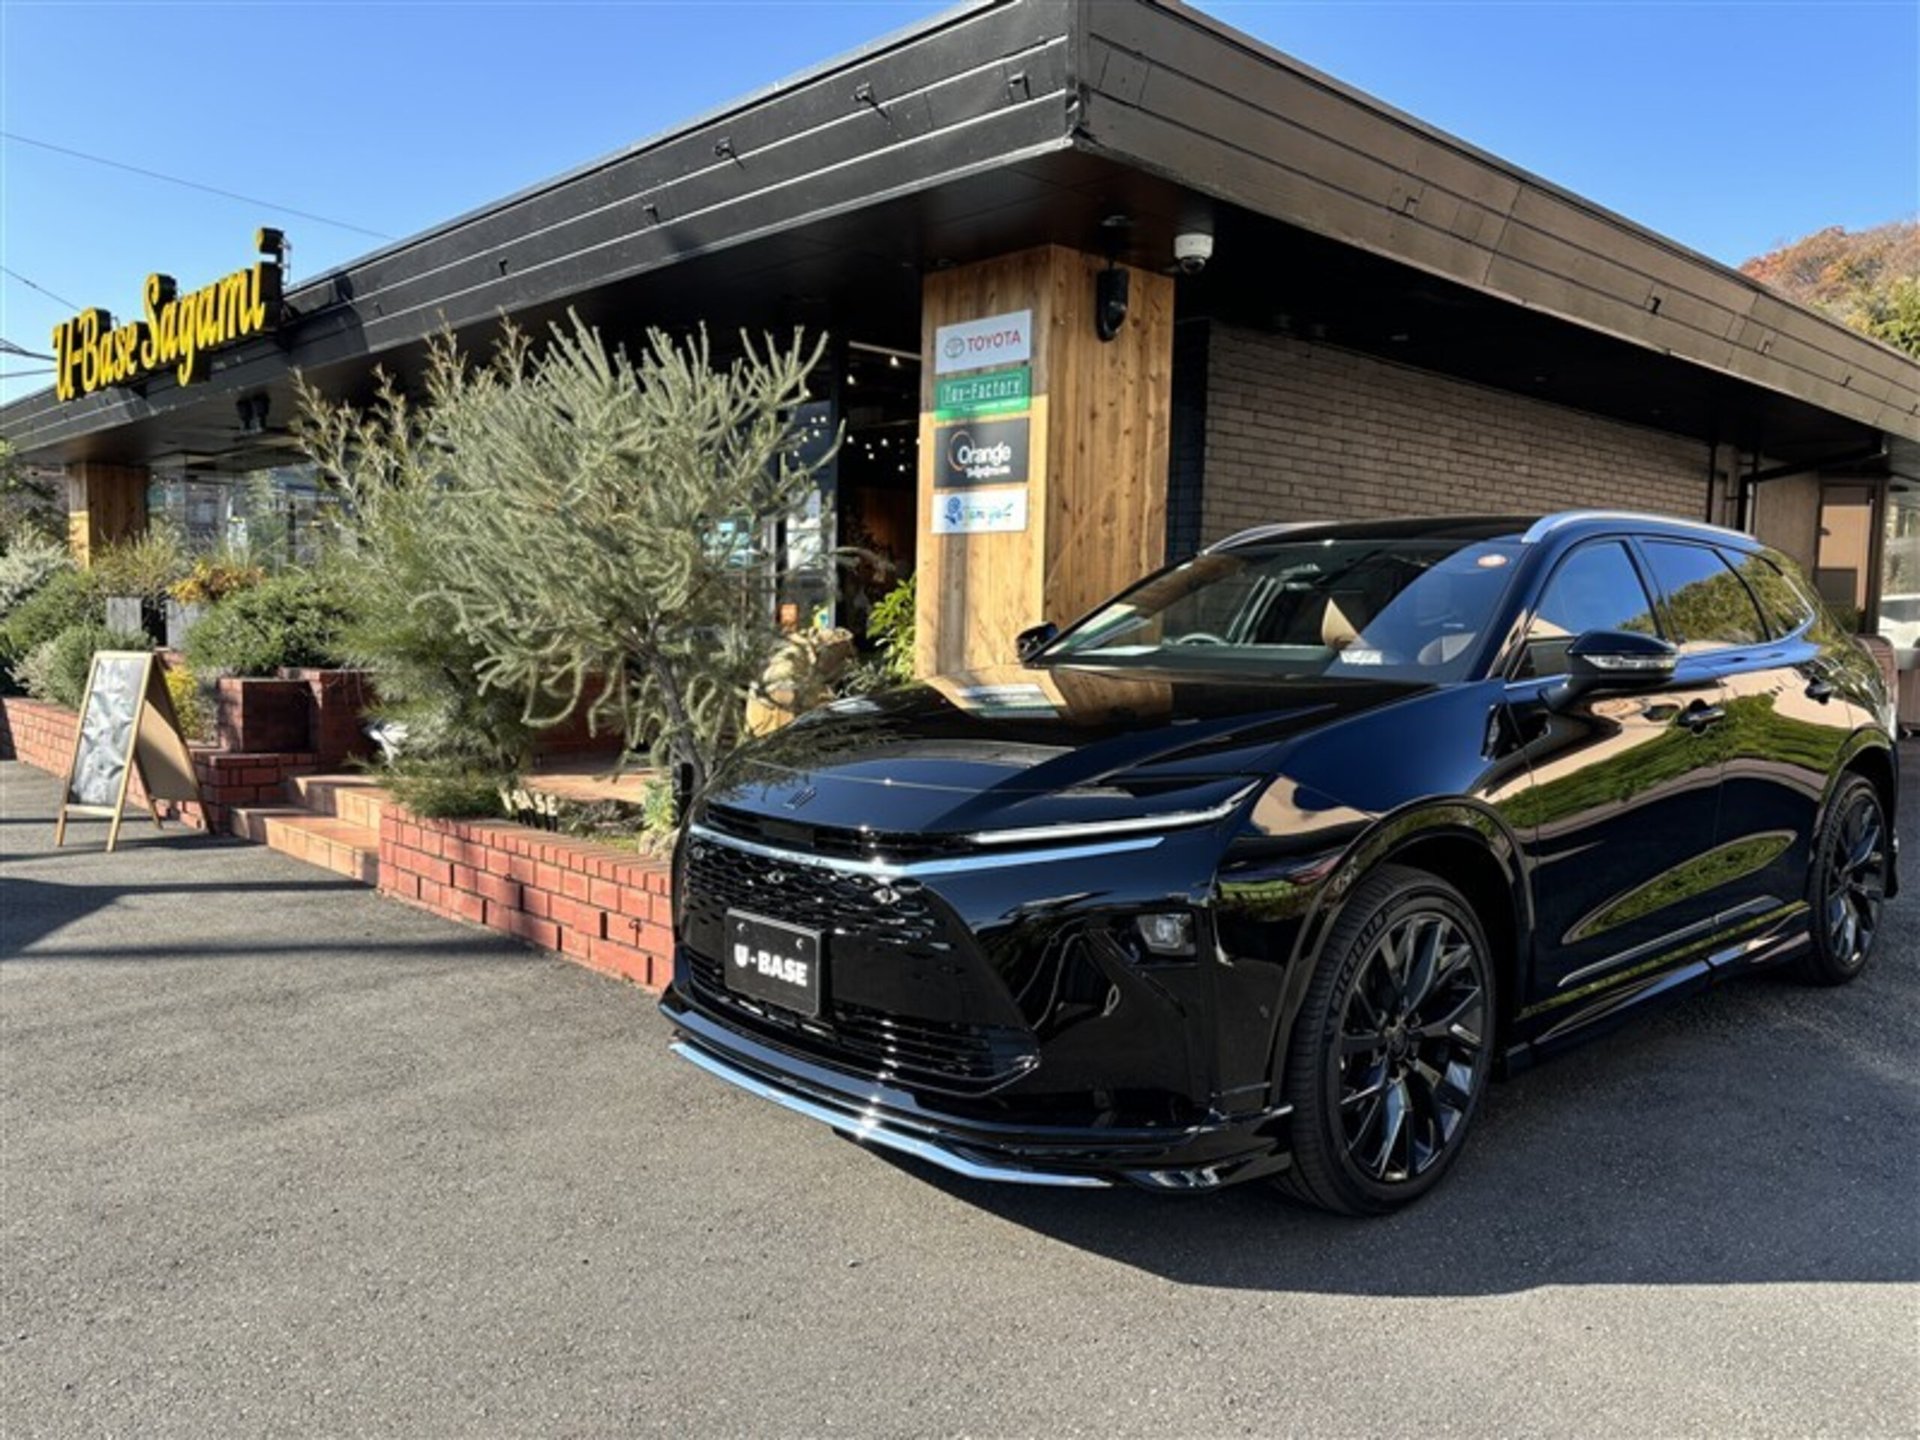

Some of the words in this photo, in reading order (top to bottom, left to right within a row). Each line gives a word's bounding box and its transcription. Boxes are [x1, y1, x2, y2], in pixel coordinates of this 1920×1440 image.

[51, 307, 139, 401] U-Base
[141, 227, 266, 387] Sagami
[966, 330, 1022, 353] TOYOTA
[957, 441, 1012, 466] Orange
[734, 943, 808, 987] U-BASE
